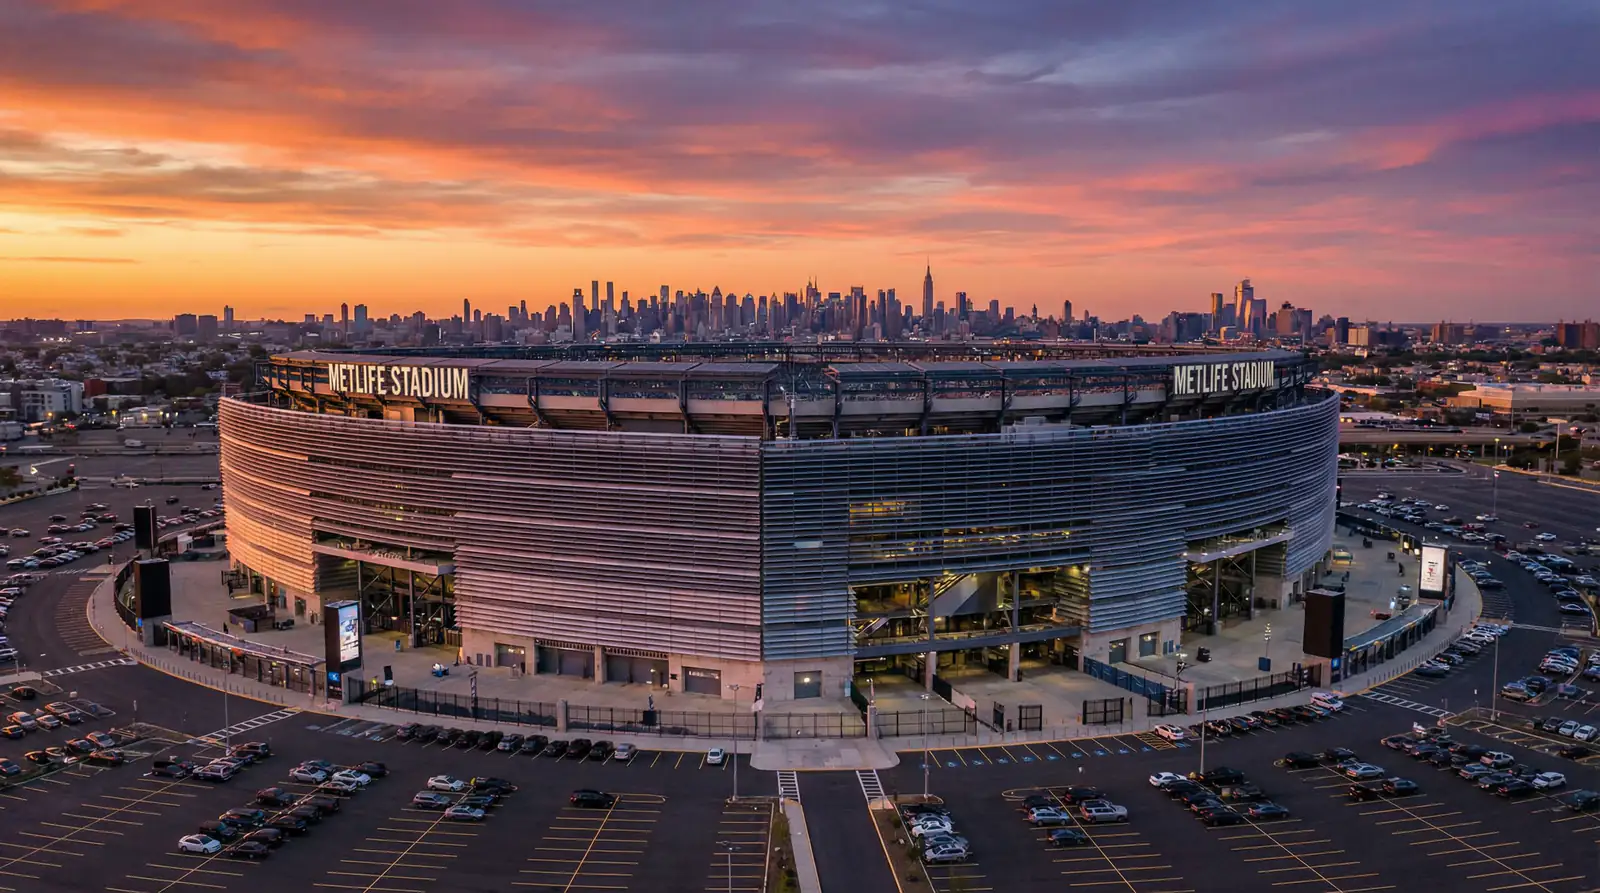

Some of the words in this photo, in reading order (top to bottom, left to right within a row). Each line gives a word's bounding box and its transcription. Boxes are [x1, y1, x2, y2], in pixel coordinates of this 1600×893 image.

[328, 363, 387, 395] METLIFE
[390, 366, 469, 399] STADIUM
[1174, 363, 1228, 395] METLIFE
[1232, 361, 1274, 391] STADIUM
